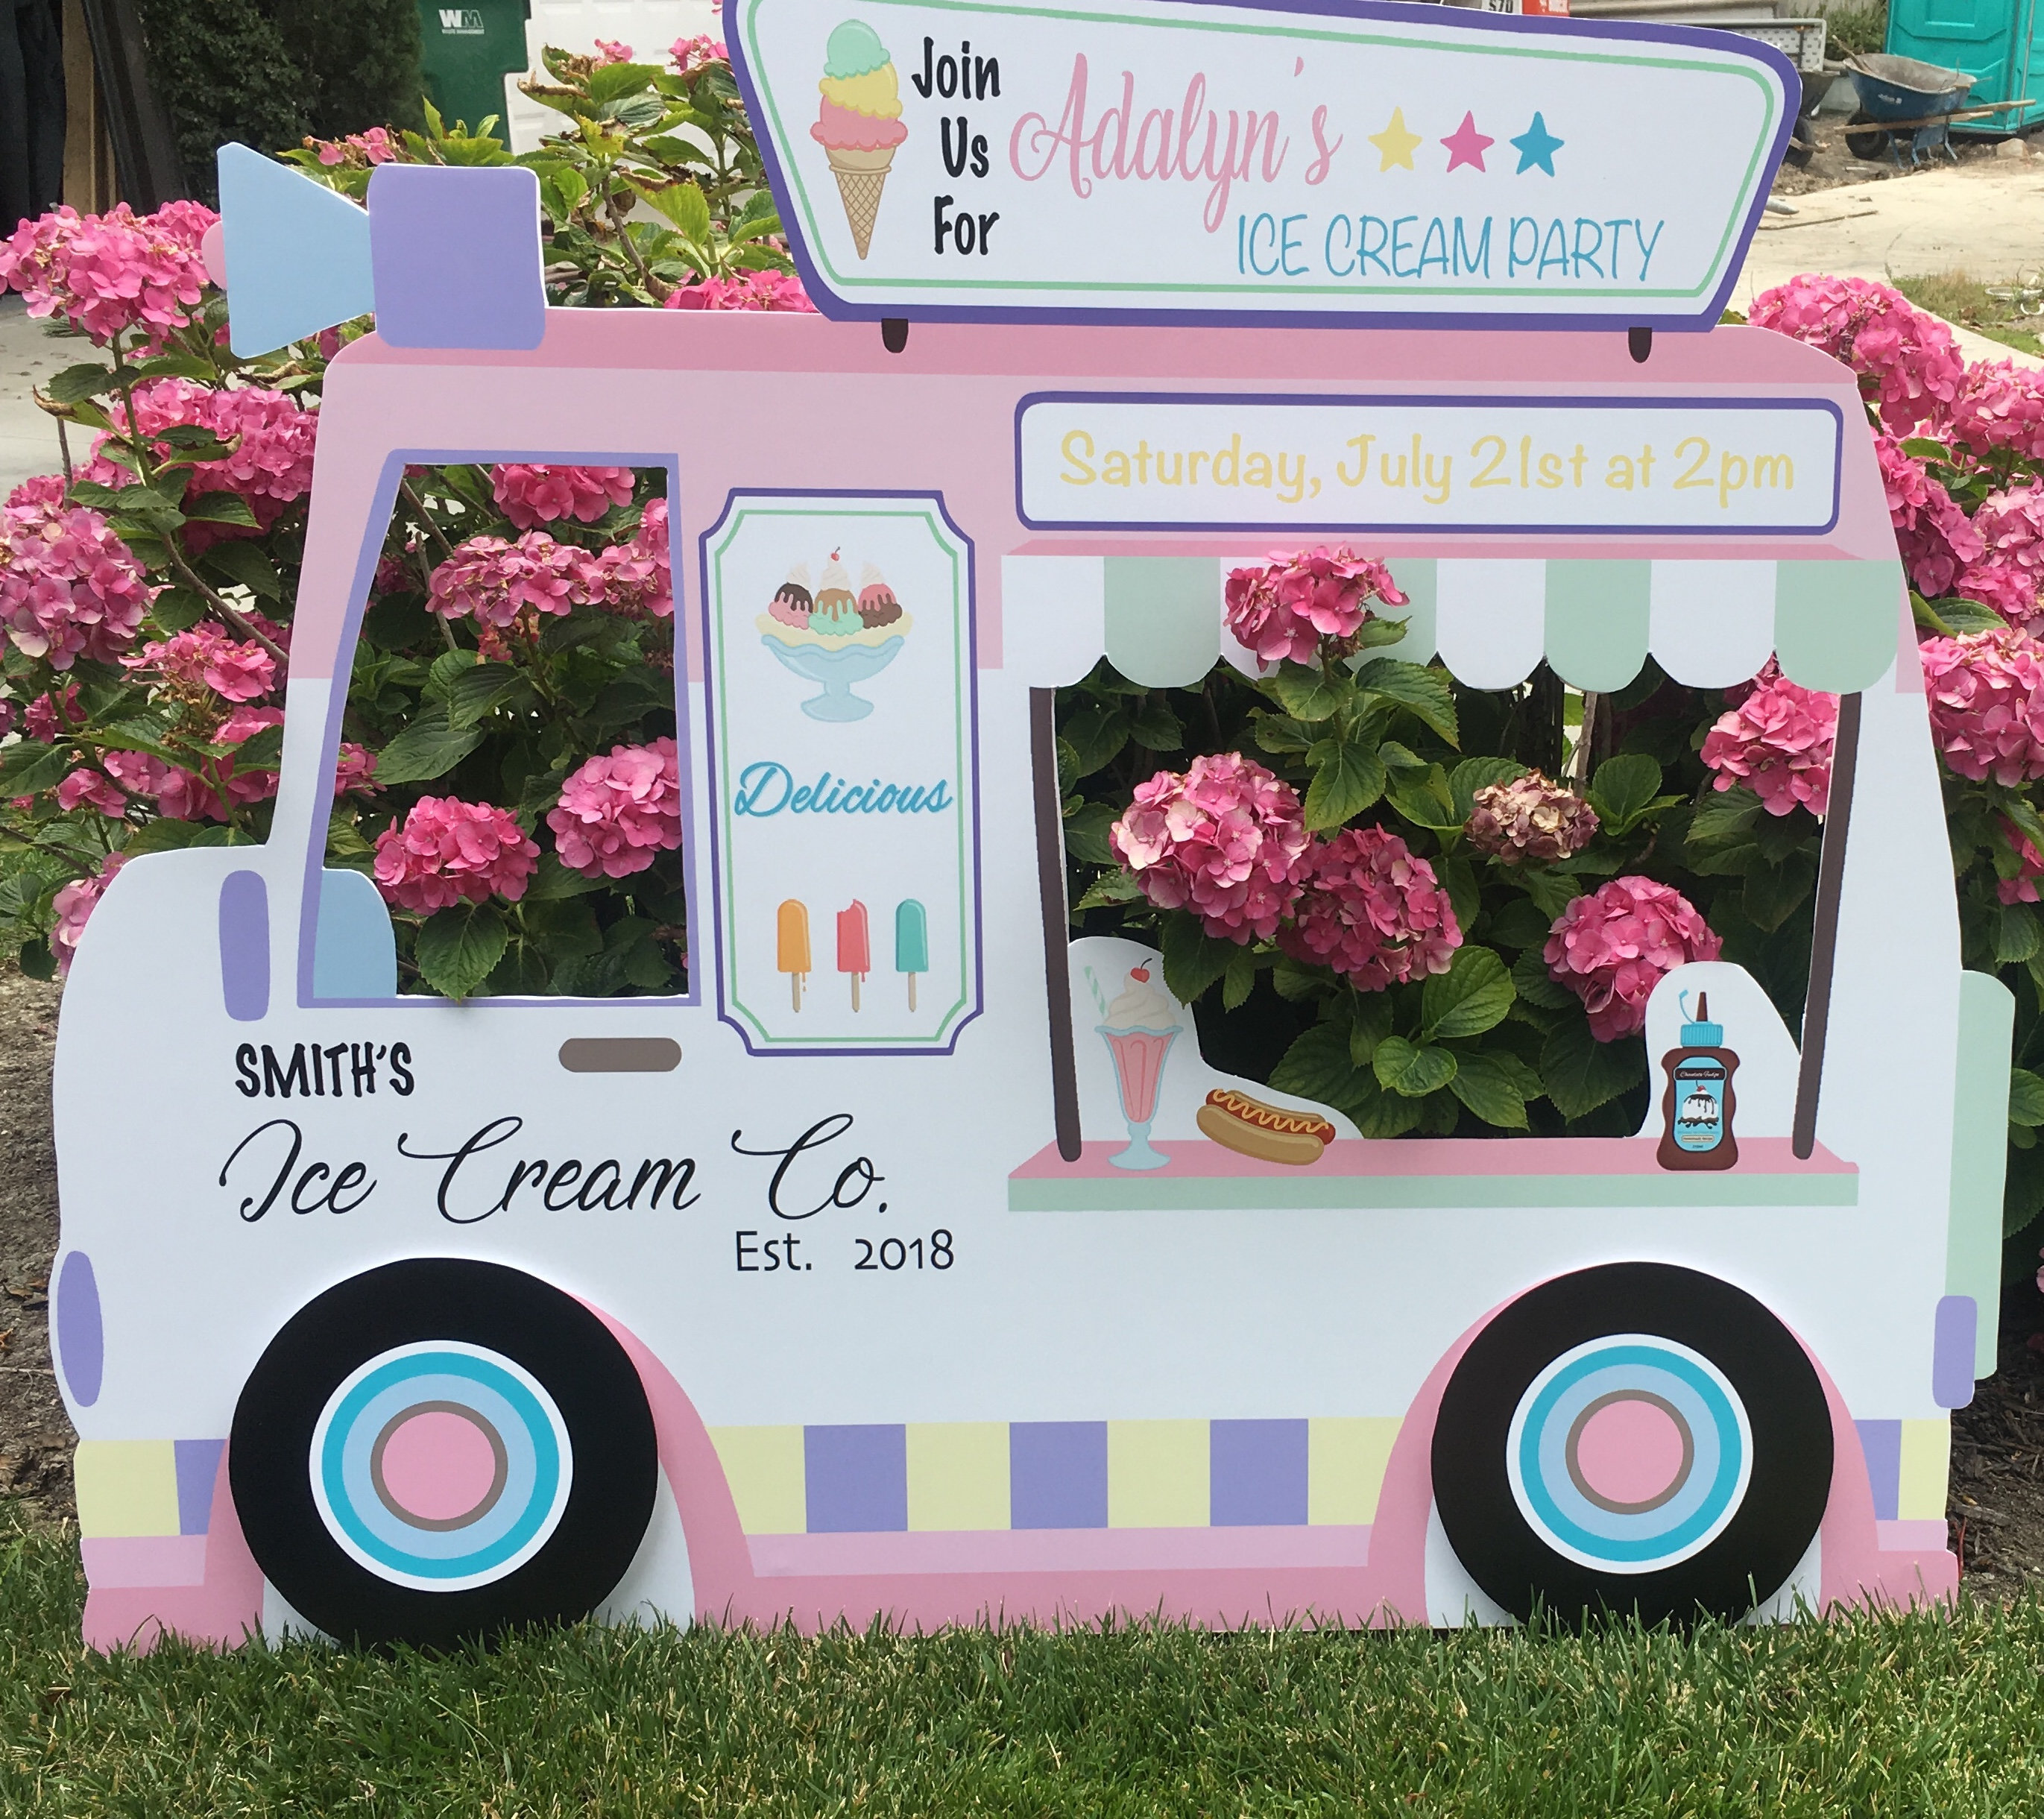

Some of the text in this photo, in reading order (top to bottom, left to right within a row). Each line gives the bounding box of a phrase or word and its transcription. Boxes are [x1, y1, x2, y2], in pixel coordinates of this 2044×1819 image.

[438, 9, 484, 28] WM
[912, 37, 1000, 101] Join
[941, 116, 988, 177] Us
[1009, 54, 1343, 233] Adalyn's
[935, 195, 1000, 255] For
[1238, 212, 1664, 281] ICE CREAM PARTY
[1060, 429, 1794, 508] Saturday, July 21st at 2pm
[734, 761, 954, 817] Delicious
[236, 1041, 414, 1098] SMITH'S
[219, 1114, 887, 1224] Ice Cream Co.
[736, 1229, 953, 1271] Est. 2018
